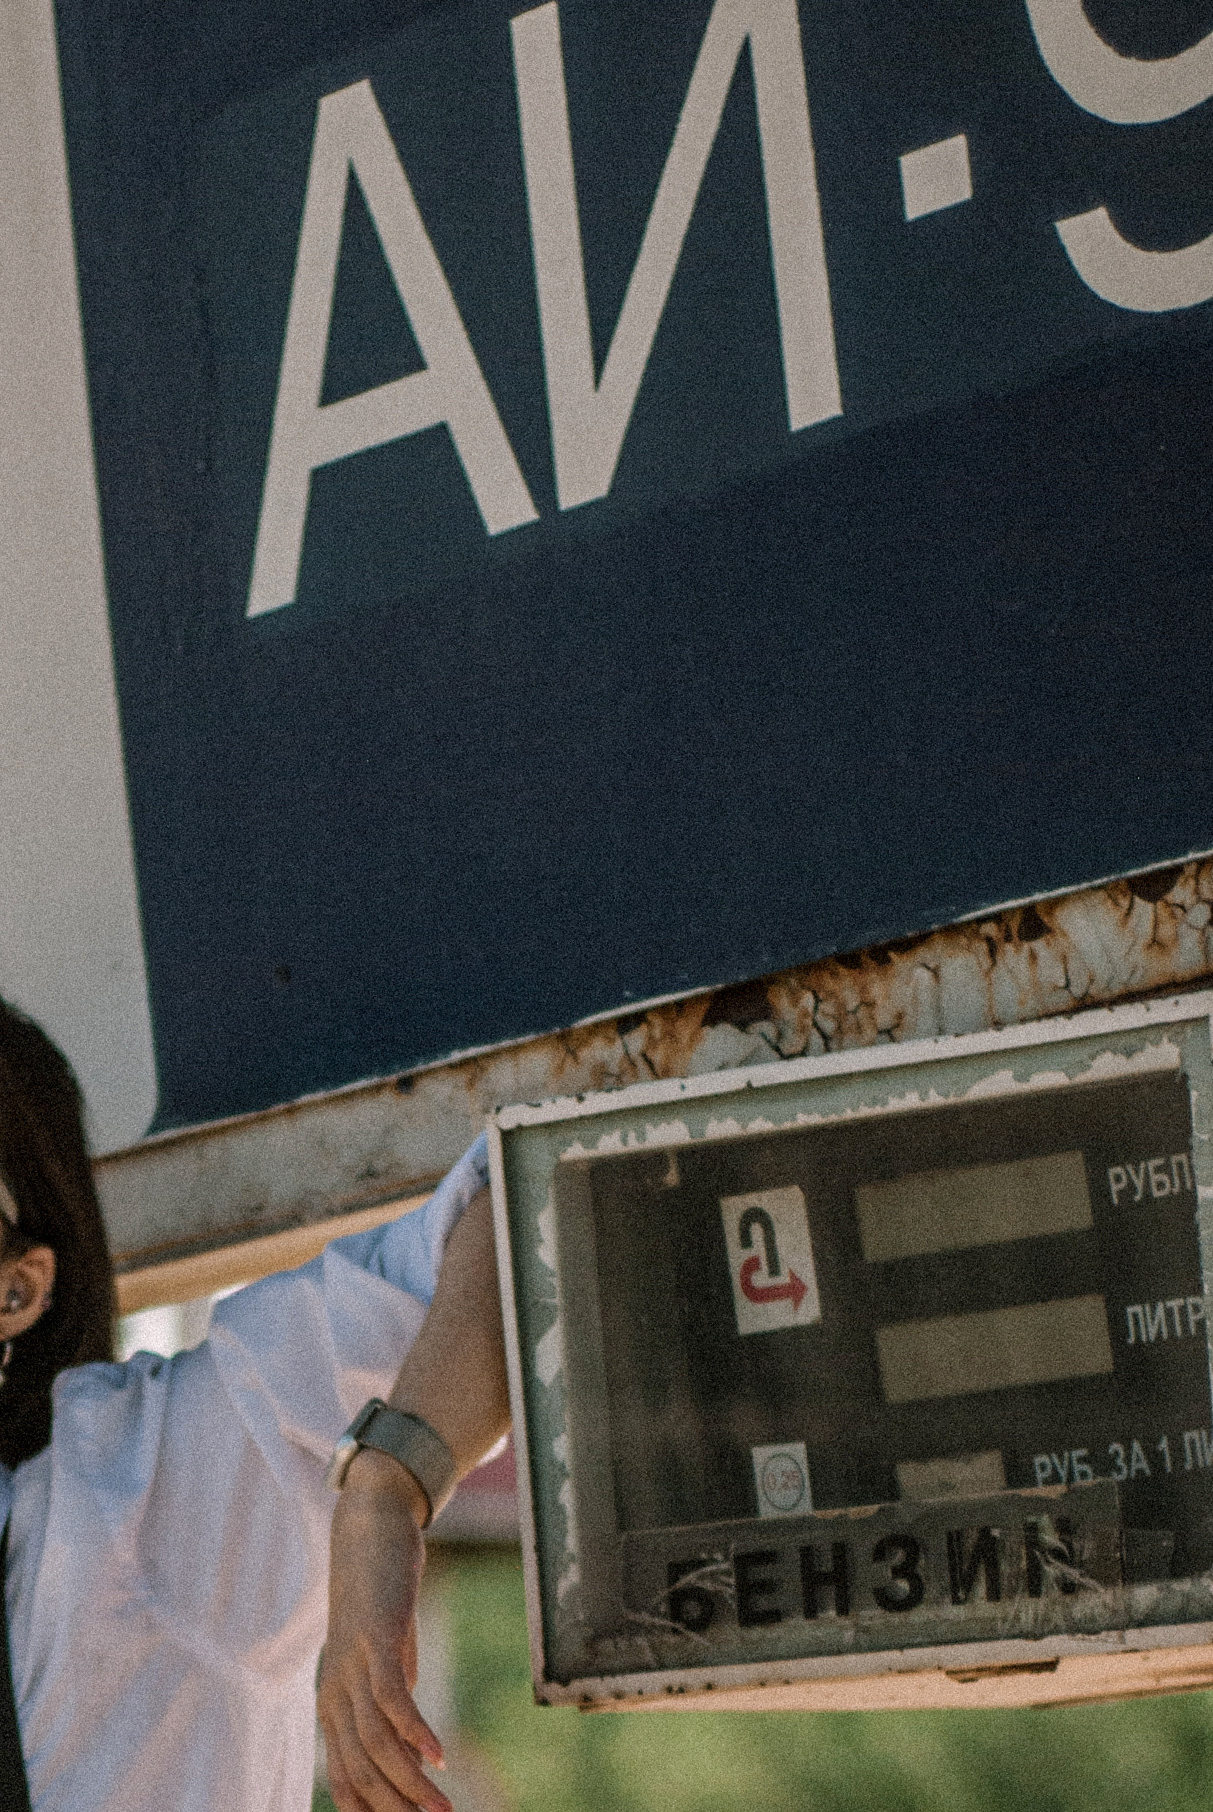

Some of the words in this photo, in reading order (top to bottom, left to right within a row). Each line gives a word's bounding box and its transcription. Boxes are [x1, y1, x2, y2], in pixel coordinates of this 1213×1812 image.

[1108, 1153, 1192, 1205] РУБЛ
[1126, 1297, 1207, 1344] ЛИТР
[1108, 1441, 1151, 1481] ЗА
[1157, 1434, 1172, 1473] 1
